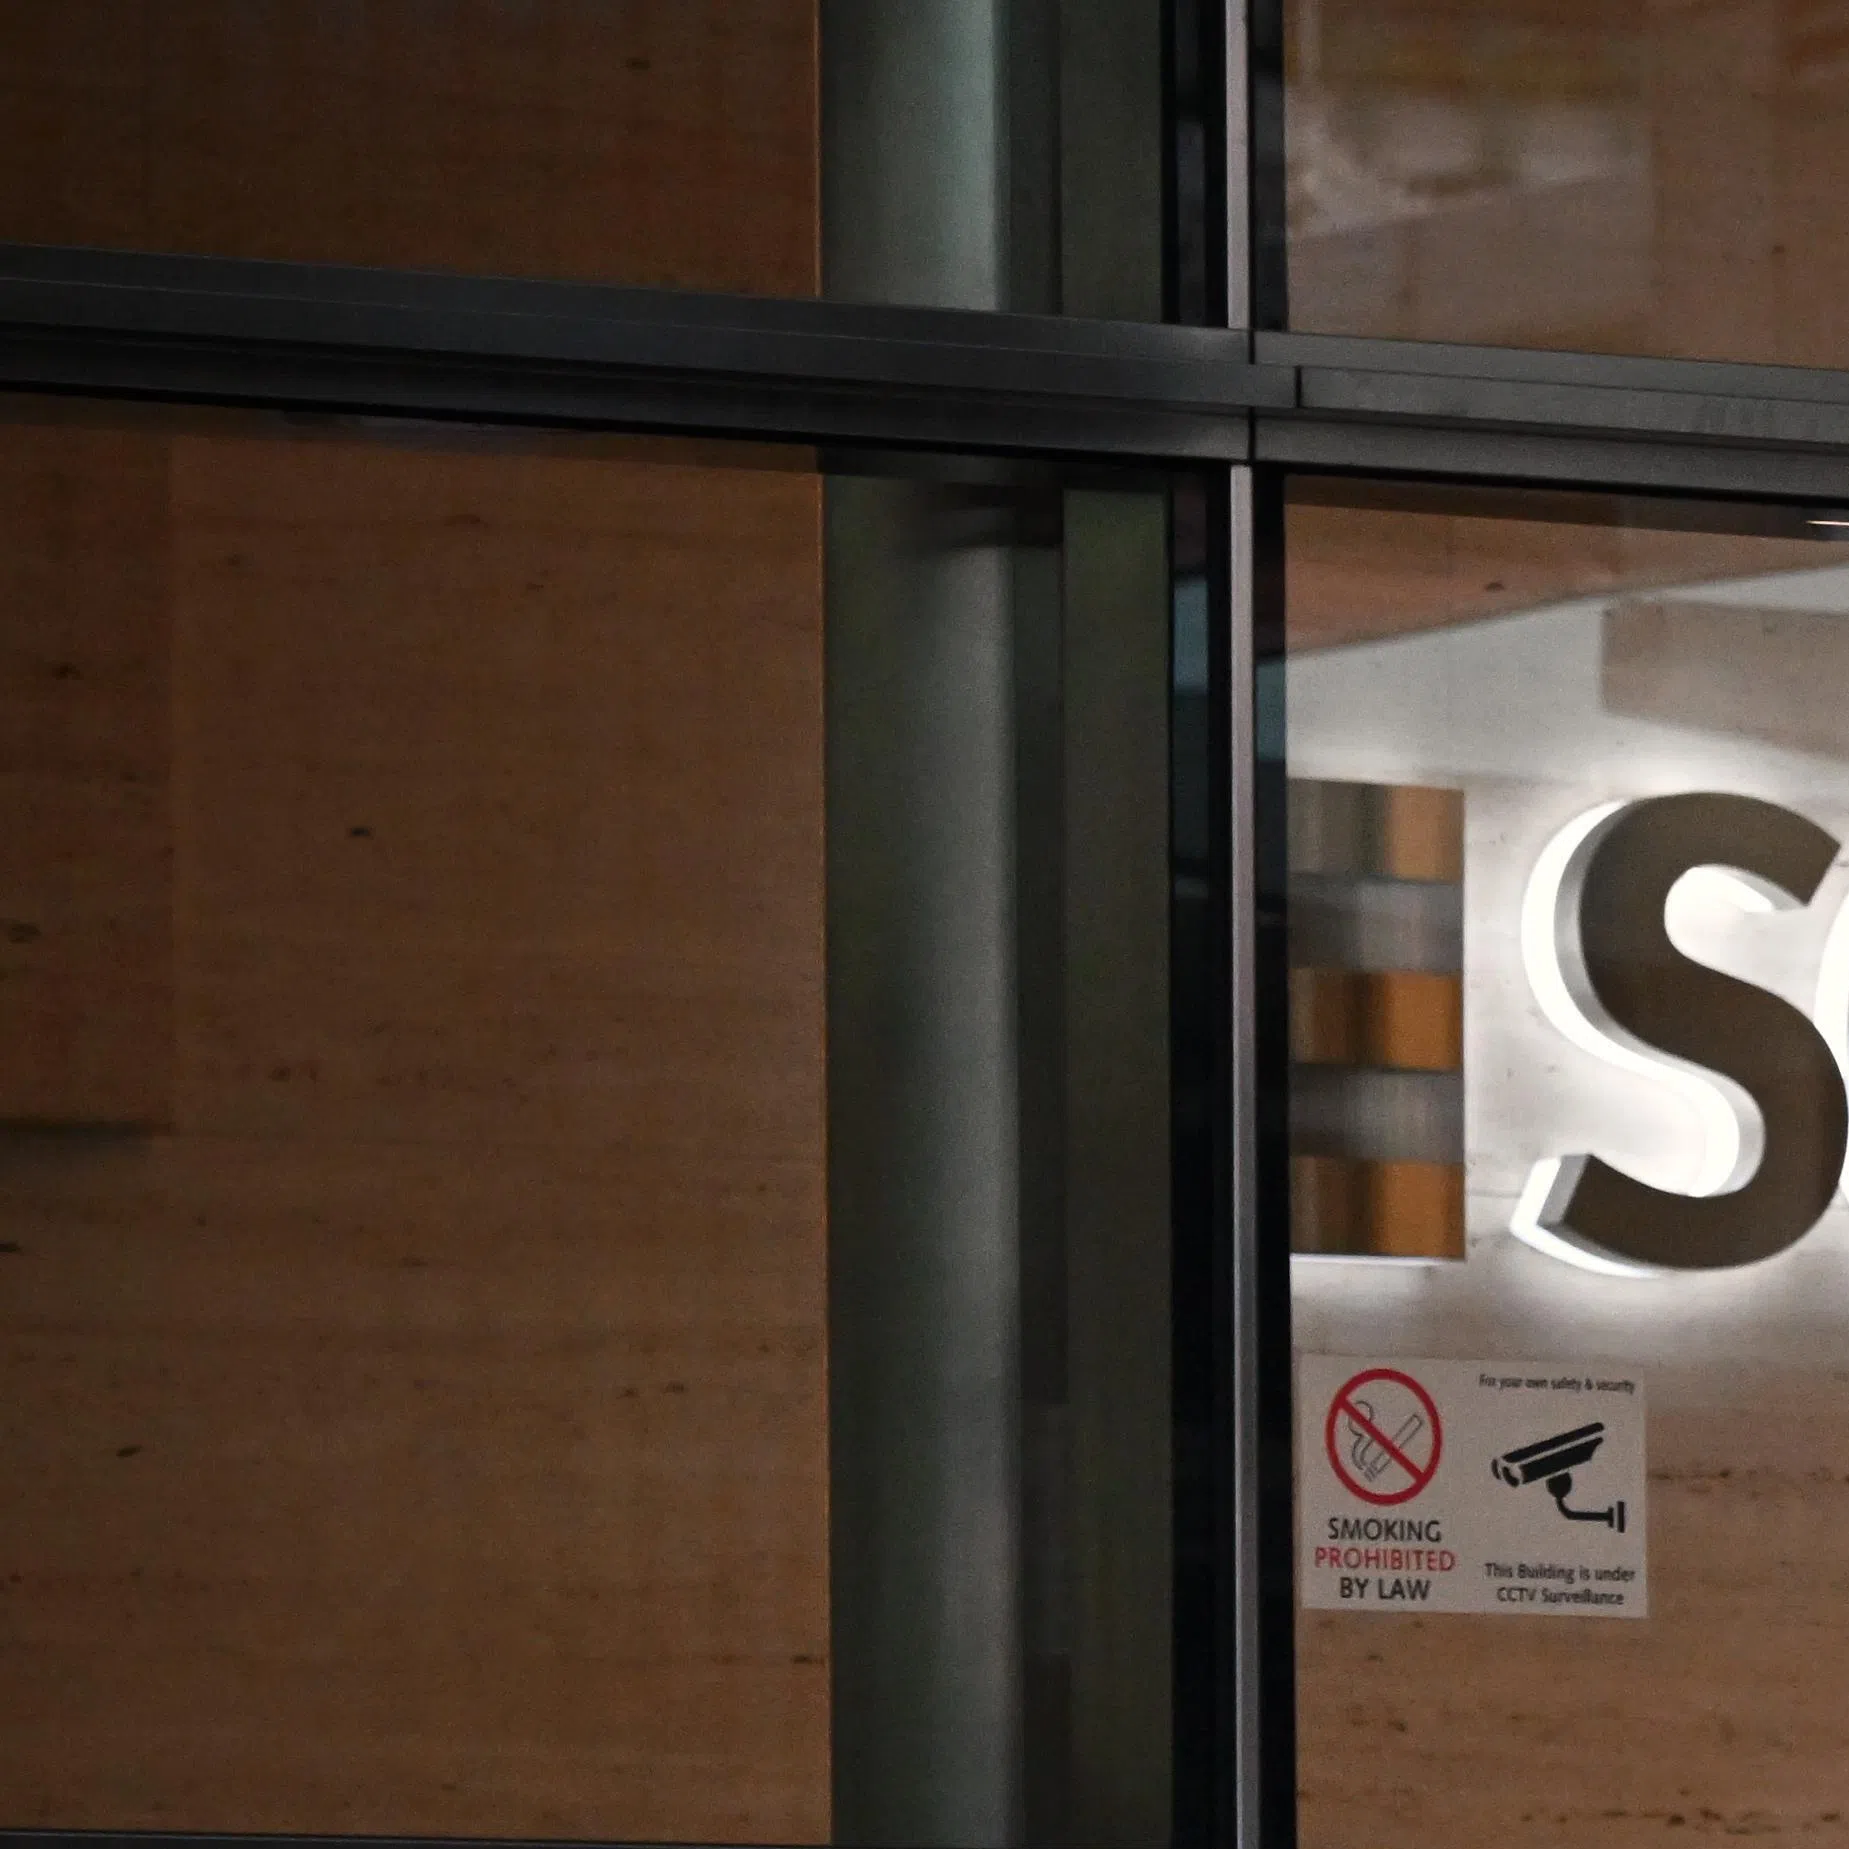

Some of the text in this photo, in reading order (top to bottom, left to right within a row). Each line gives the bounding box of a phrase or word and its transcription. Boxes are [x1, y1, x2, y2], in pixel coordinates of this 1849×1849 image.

[1327, 1516, 1442, 1543] SMOKING
[1314, 1546, 1457, 1573] PROHIBITED
[1485, 1562, 1636, 1585] This Building is under
[1339, 1576, 1431, 1601] BY LAW
[1496, 1586, 1537, 1602] CCTV
